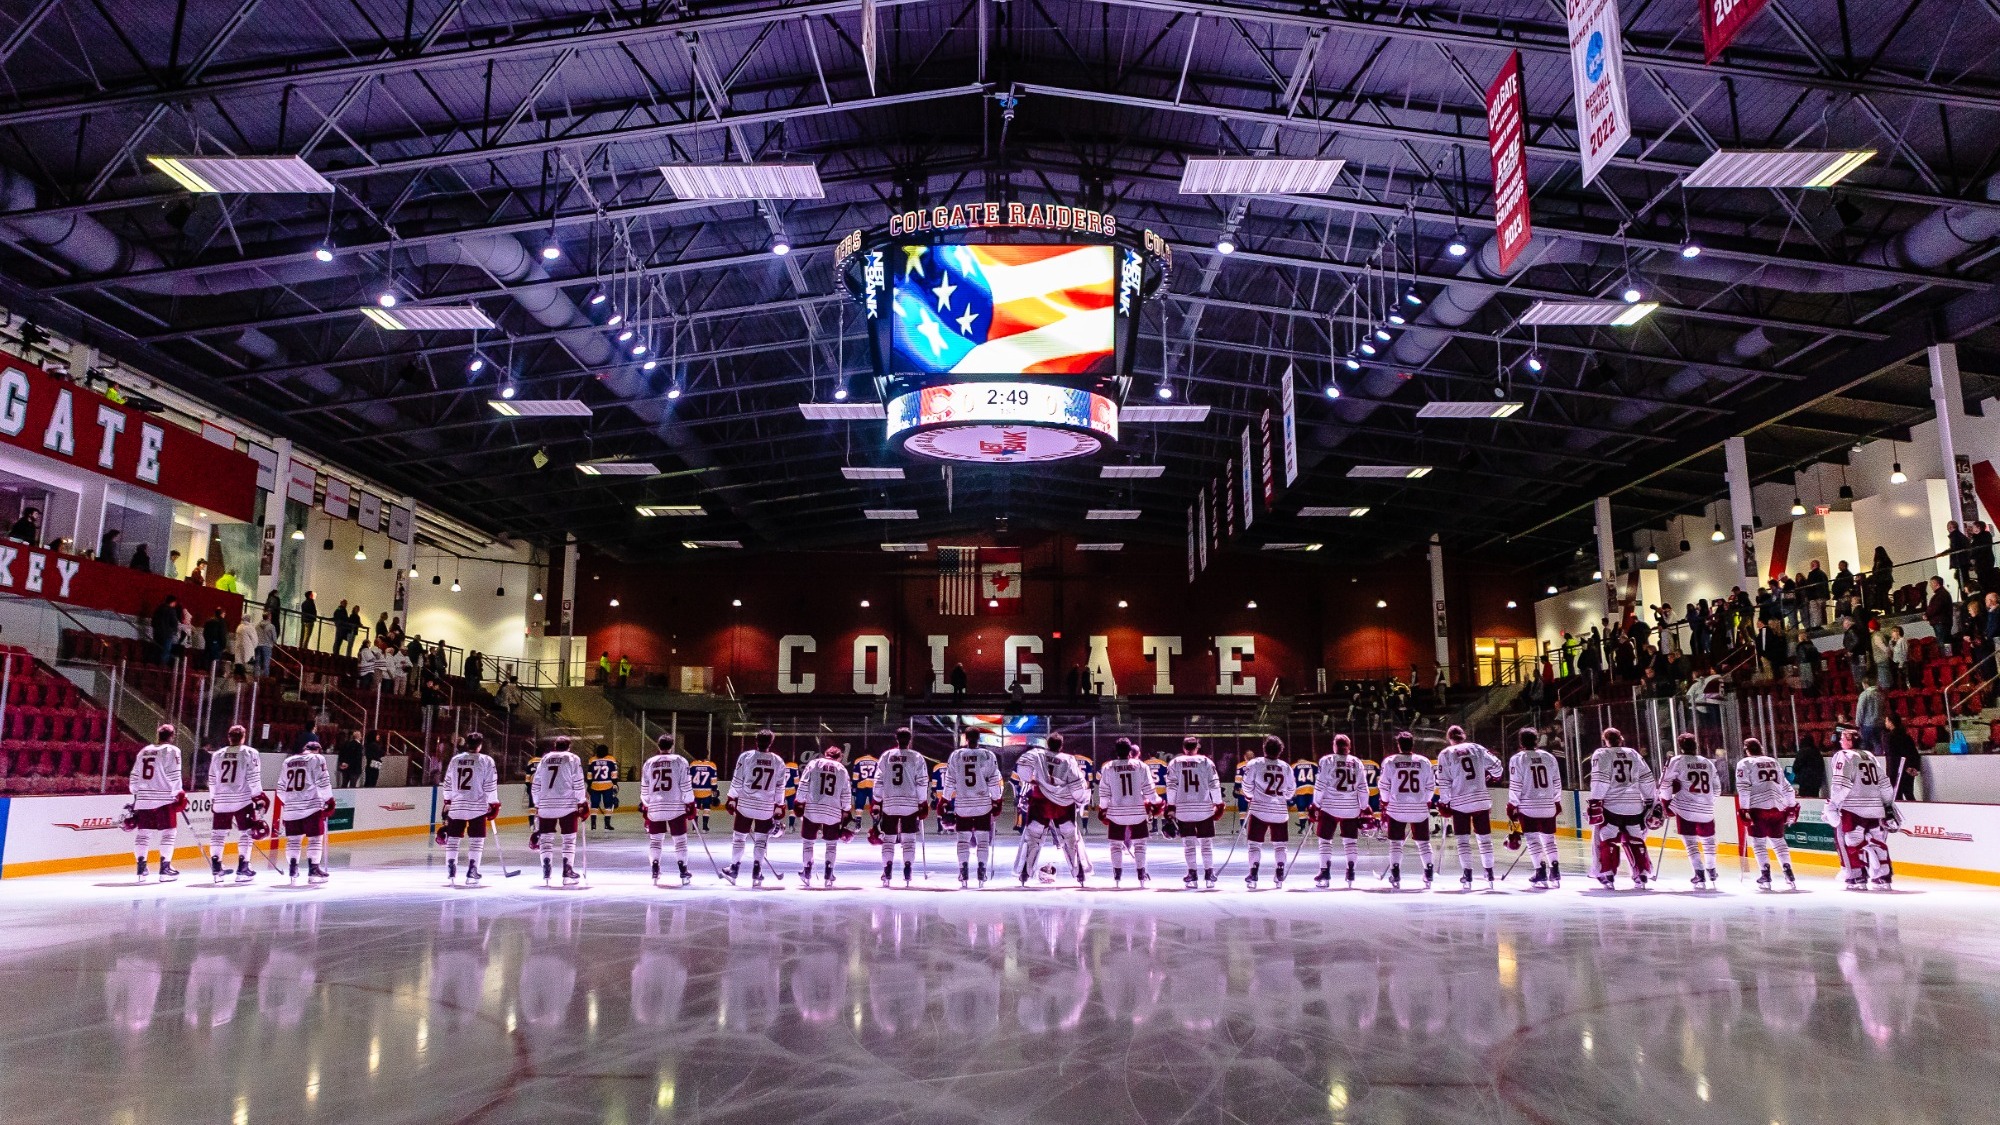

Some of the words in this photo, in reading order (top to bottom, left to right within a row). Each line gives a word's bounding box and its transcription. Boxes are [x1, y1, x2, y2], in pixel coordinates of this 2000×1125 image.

[1713, 0, 1741, 27] 20
[1489, 72, 1518, 131] COLGATE
[1585, 73, 1611, 111] REGIONAL
[1591, 91, 1610, 123] FINALS
[1590, 111, 1616, 157] 2022
[889, 202, 1000, 237] COLGATE
[1008, 202, 1117, 236] RAIDERS
[1504, 213, 1523, 250] 2023
[872, 251, 885, 291] NBT
[864, 265, 878, 319] BANK
[1119, 259, 1133, 317] BANK
[987, 389, 1029, 406] 2:49
[0, 366, 165, 484] GATE
[1957, 463, 1971, 473] 16
[1743, 531, 1753, 540] 15
[0, 546, 80, 598] KEY
[777, 633, 1257, 695] COLGATE
[221, 760, 238, 783] 21
[286, 768, 306, 792] 20
[457, 767, 474, 790] 12
[547, 766, 559, 789] 7
[593, 765, 610, 780] 73
[652, 768, 672, 792] 25
[692, 771, 710, 786] 47
[751, 767, 774, 791] 27
[860, 765, 876, 779] 57
[892, 763, 904, 786] 3
[965, 764, 977, 787] 5
[1298, 768, 1314, 783] 44
[1335, 768, 1357, 792] 24
[1461, 756, 1476, 780] 9
[1530, 765, 1549, 789] 10
[1613, 760, 1633, 783] 37
[1858, 762, 1878, 785] 30
[819, 772, 836, 797] 13
[1119, 773, 1133, 796] 11
[1181, 769, 1200, 793] 14
[1263, 772, 1284, 796] 22
[1397, 769, 1420, 793] 26
[1687, 770, 1710, 794] 28
[82, 817, 112, 827] HALE
[1914, 825, 1946, 836] HALE
